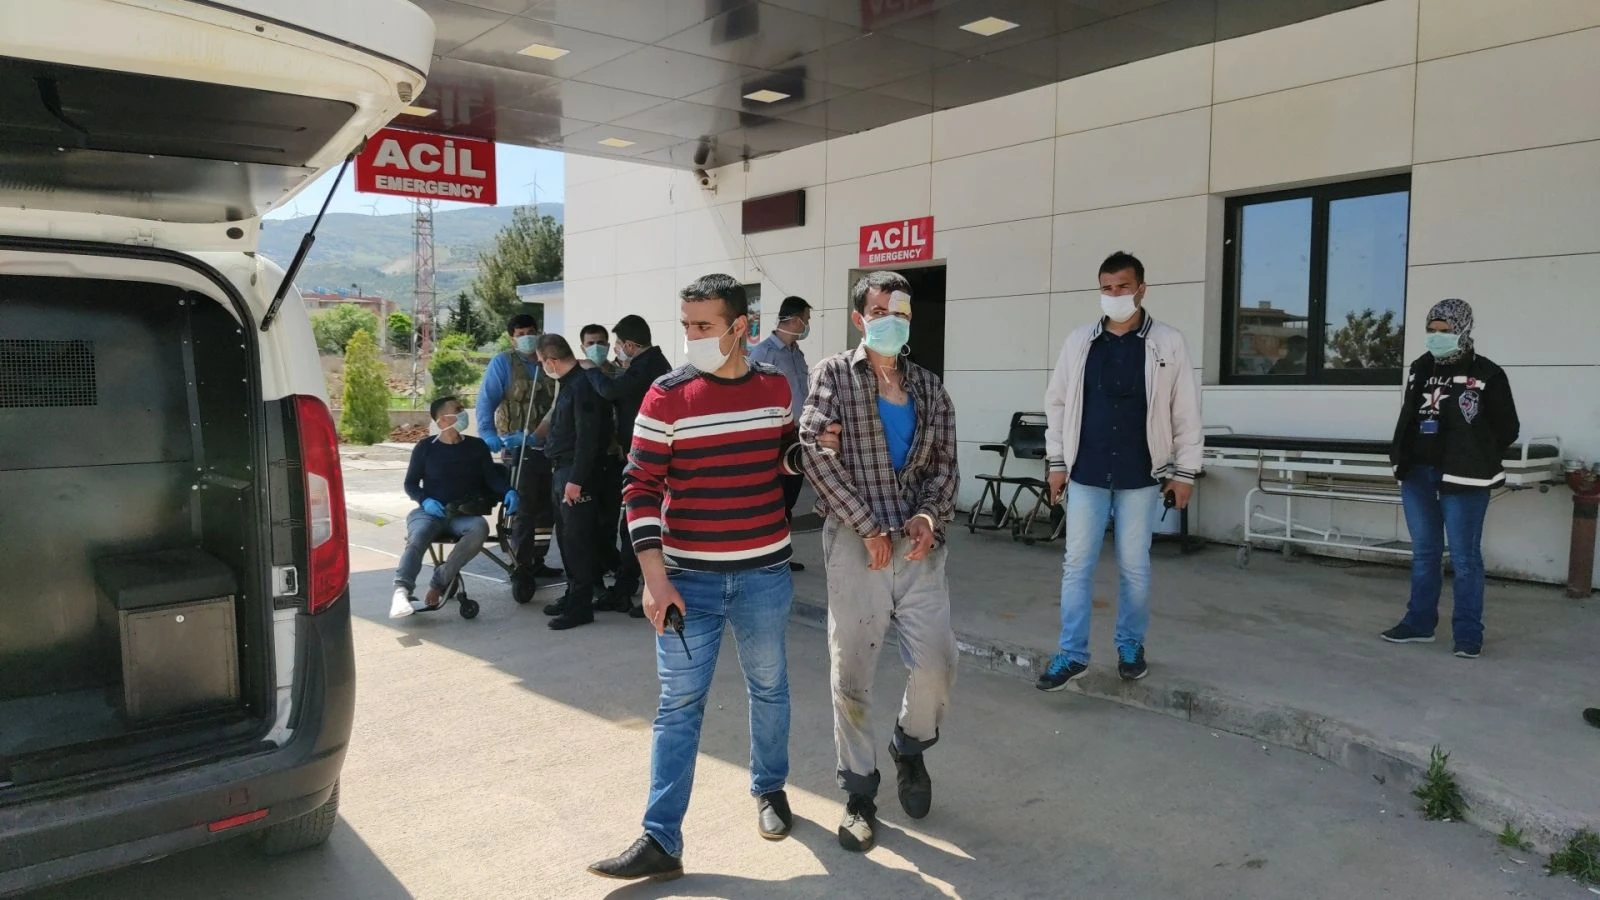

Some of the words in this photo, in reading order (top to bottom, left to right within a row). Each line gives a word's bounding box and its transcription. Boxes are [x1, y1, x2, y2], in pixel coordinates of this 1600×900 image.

[372, 138, 487, 179] ACİL
[375, 175, 483, 199] EMERGENCY
[866, 221, 926, 252] ACİL
[868, 249, 922, 263] EMERGENCY
